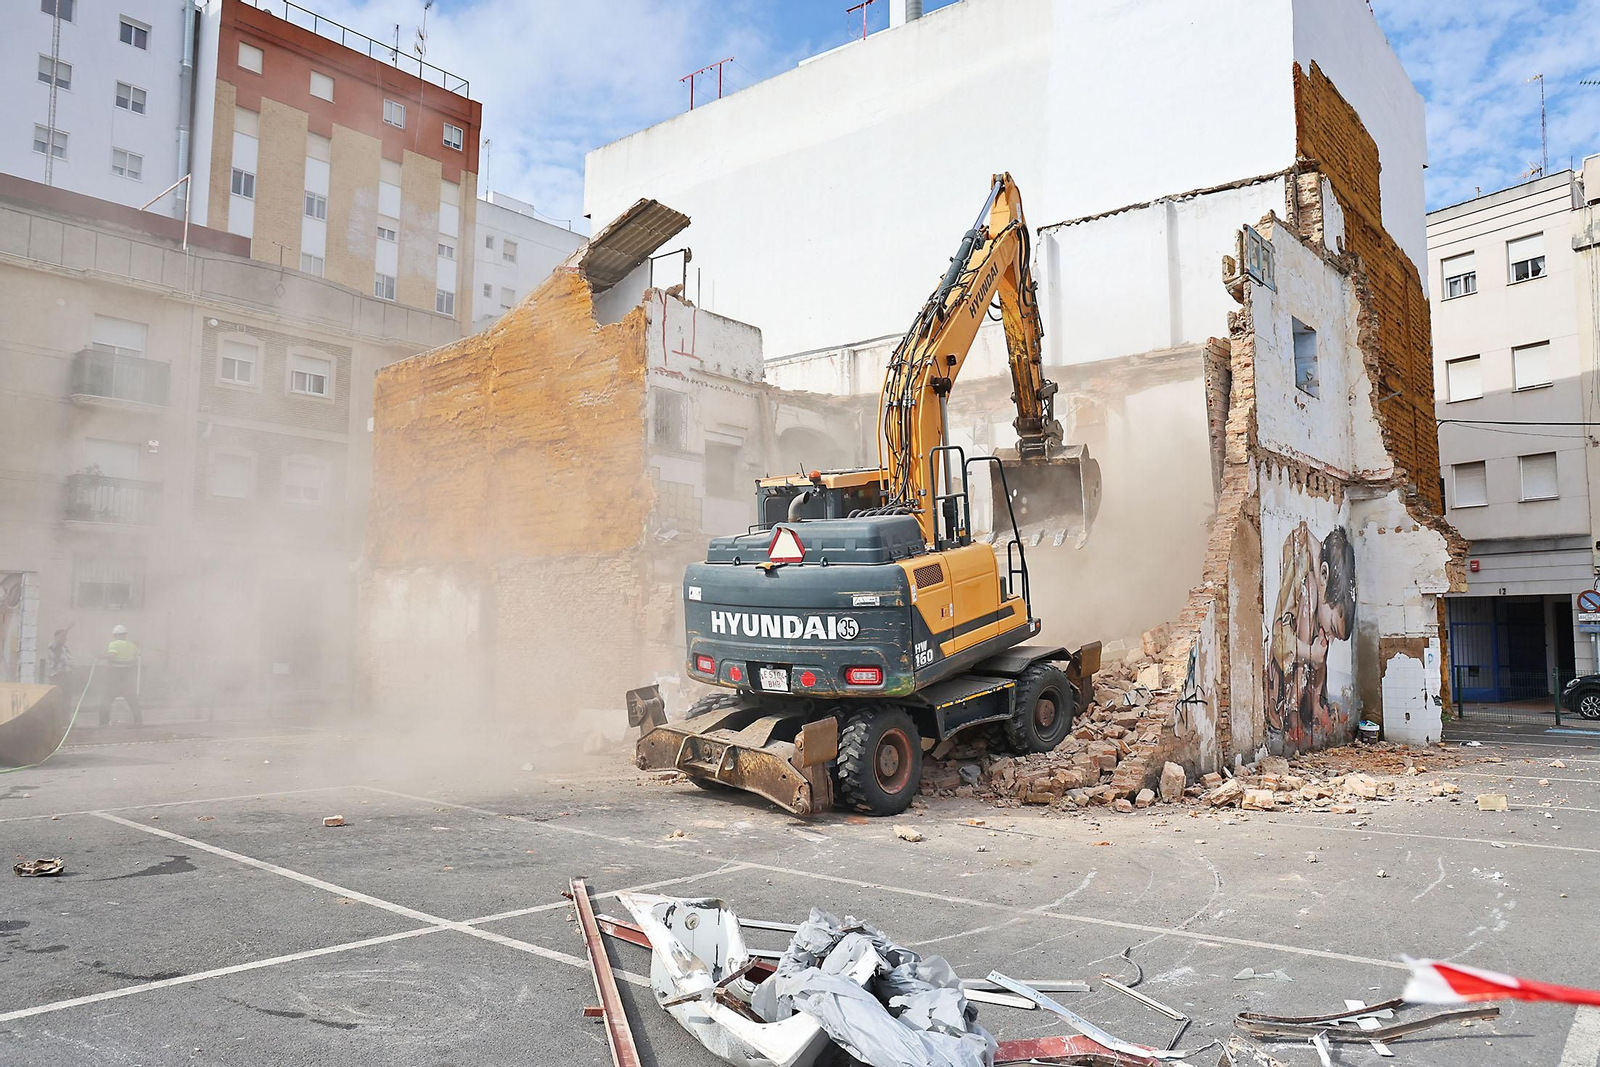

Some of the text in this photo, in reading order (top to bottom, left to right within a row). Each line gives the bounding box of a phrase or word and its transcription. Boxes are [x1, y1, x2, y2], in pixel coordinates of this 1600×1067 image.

[969, 261, 999, 319] HYUNDAI
[710, 610, 838, 640] HYUNDAI
[840, 619, 856, 638] 35
[914, 640, 928, 655] HW
[914, 648, 934, 668] 160
